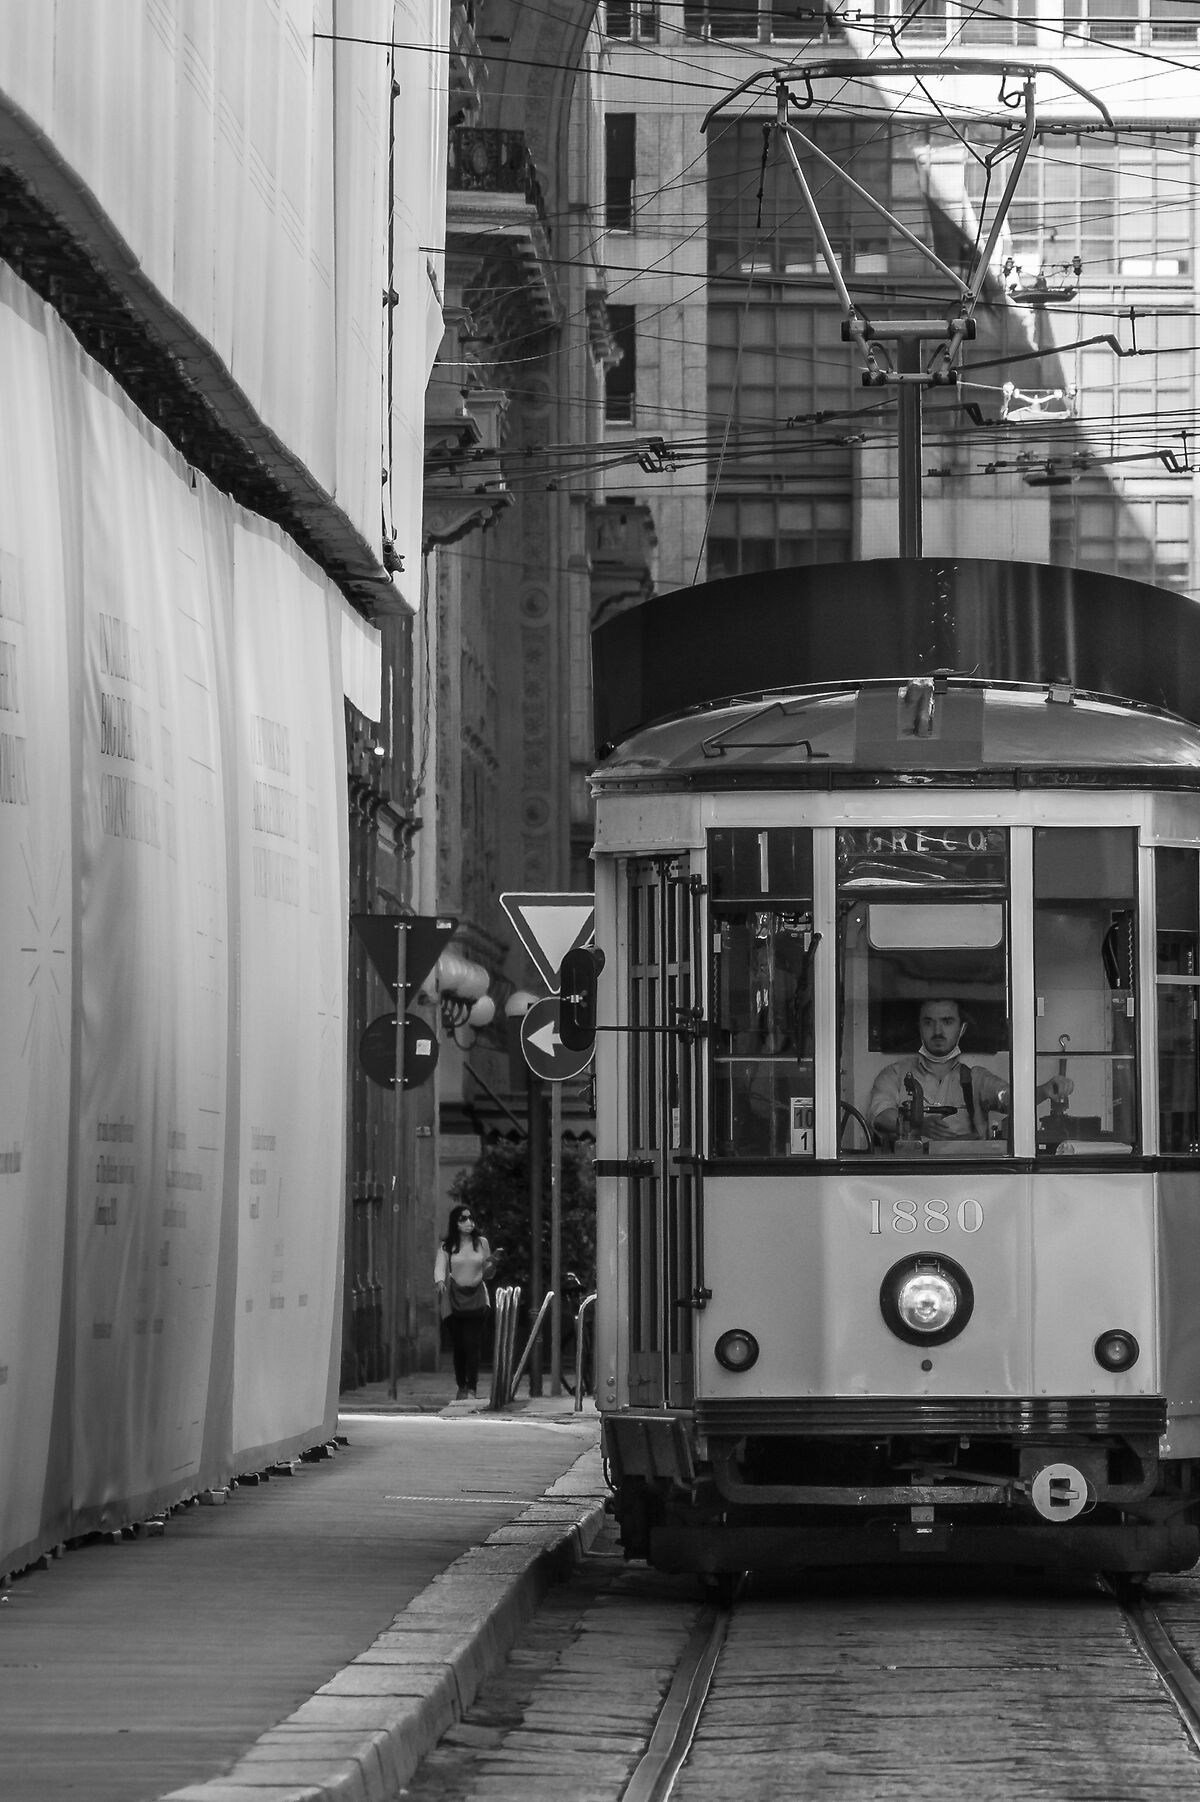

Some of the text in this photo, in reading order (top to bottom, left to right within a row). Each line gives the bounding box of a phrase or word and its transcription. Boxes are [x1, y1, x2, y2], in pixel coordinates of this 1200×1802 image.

[757, 831, 769, 893] 1
[800, 1131, 808, 1151] 1
[869, 1198, 984, 1235] 1880
